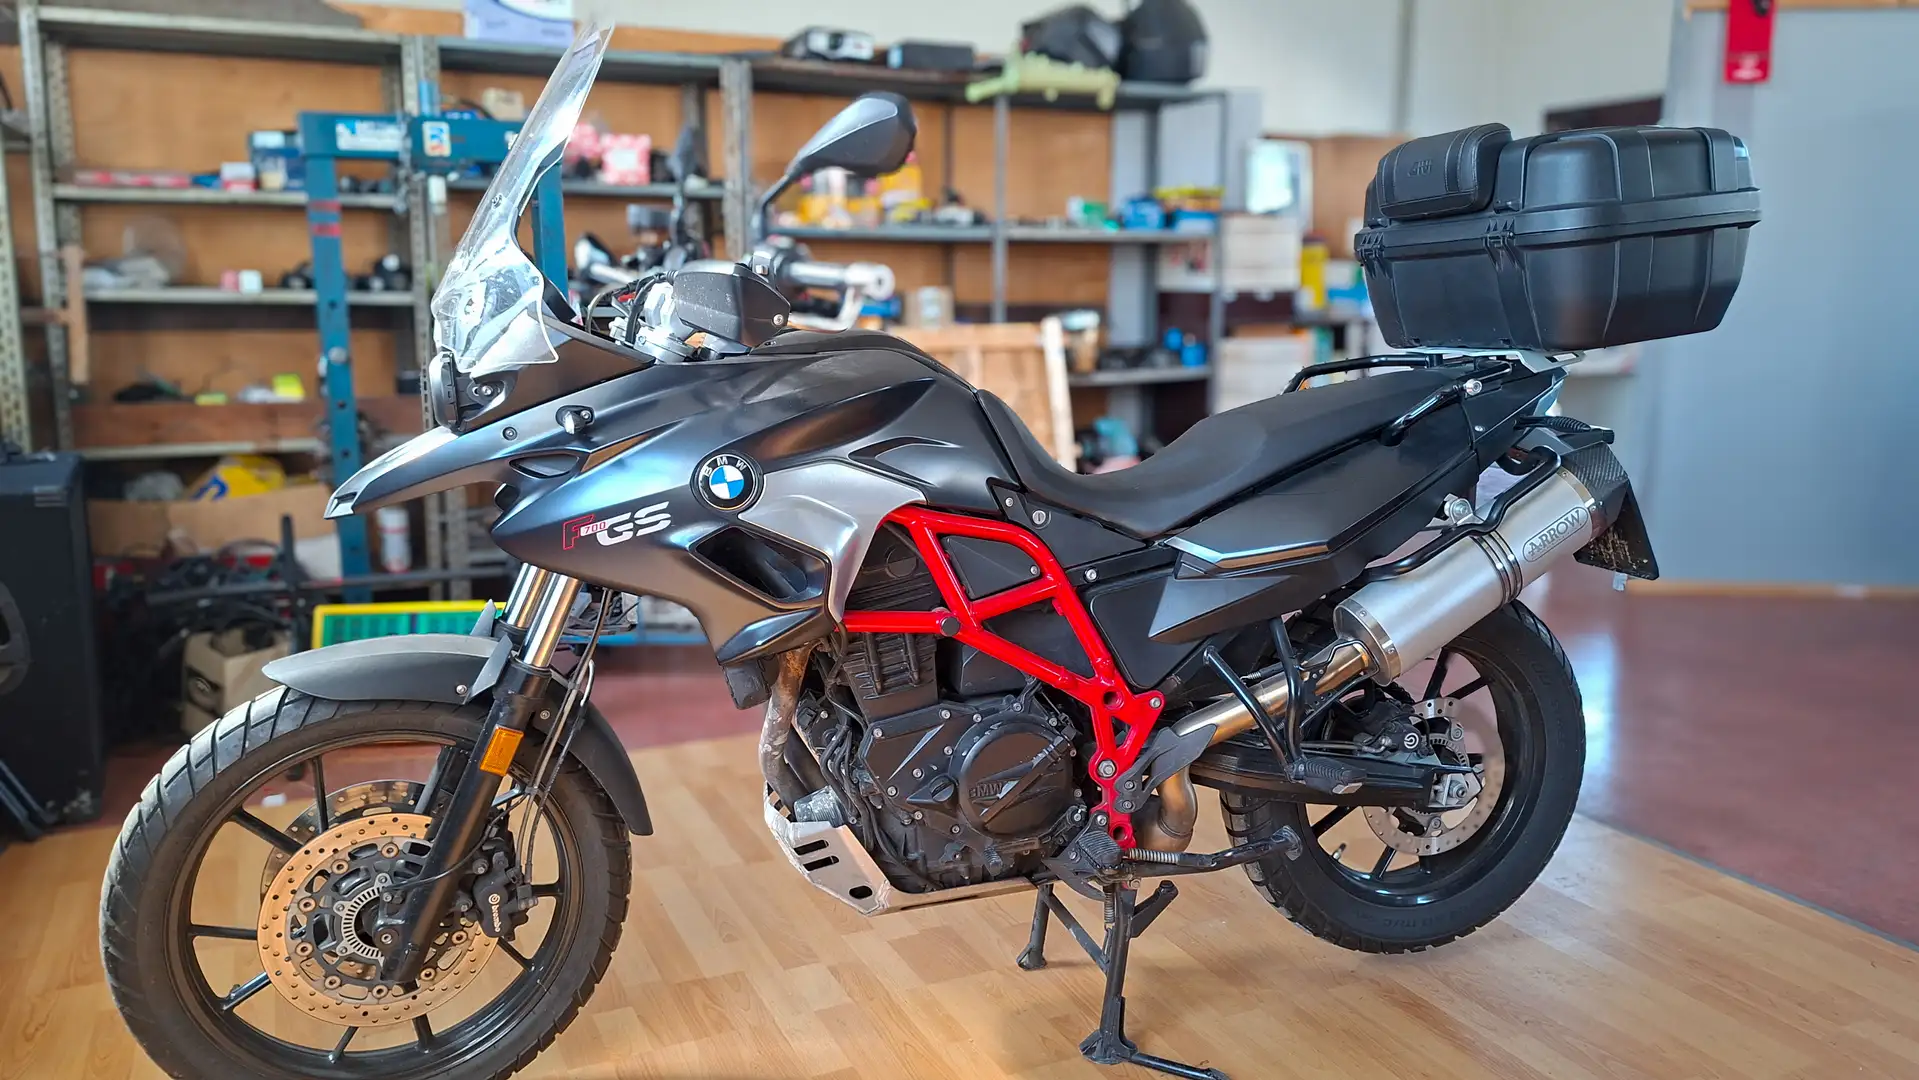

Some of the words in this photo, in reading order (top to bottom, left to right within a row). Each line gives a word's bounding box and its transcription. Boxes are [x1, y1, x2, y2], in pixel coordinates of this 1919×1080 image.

[704, 456, 748, 477] BMW
[563, 513, 596, 551] F
[584, 520, 608, 534] 700
[596, 501, 672, 547] GS
[1528, 509, 1581, 557] ARROW
